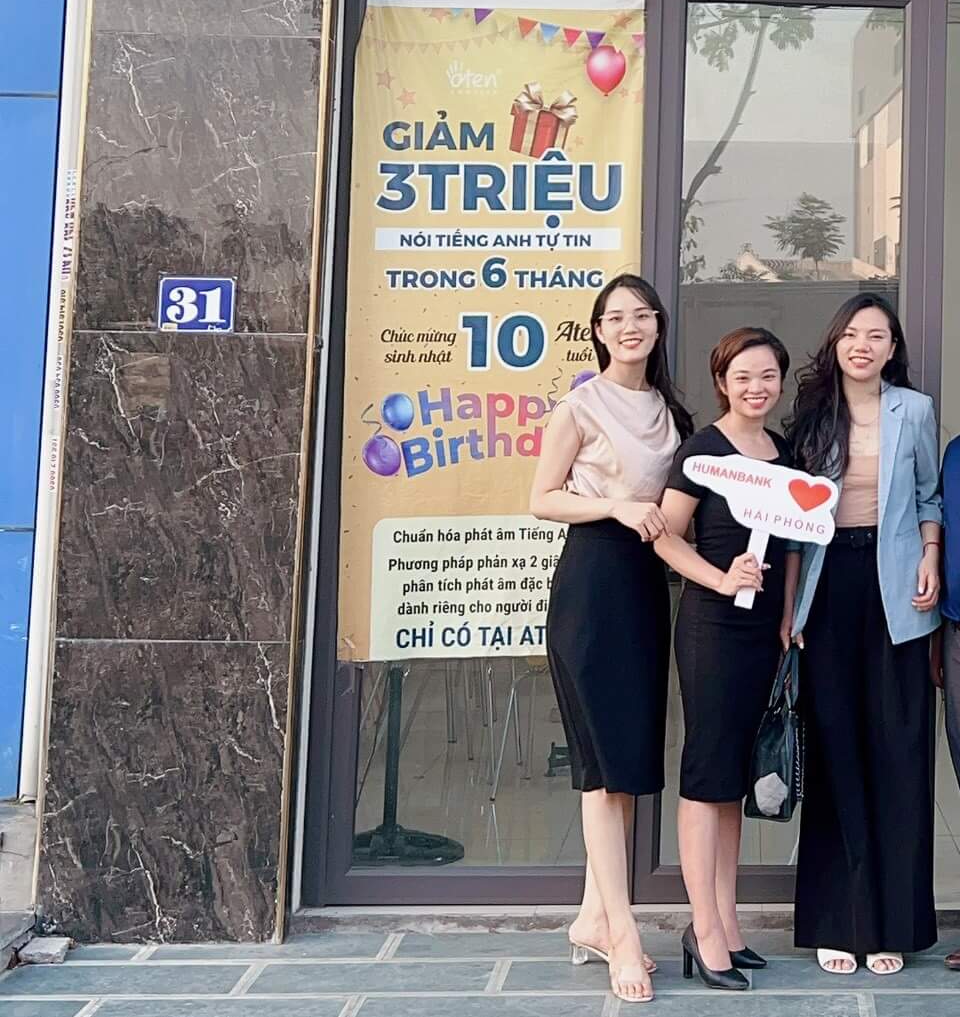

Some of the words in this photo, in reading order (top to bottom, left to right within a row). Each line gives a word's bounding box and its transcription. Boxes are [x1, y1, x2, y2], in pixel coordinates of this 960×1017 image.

[382, 110, 495, 151] GIẢM
[400, 231, 431, 247] NÓI
[436, 229, 488, 247] TIẾNG
[493, 234, 531, 247] ANH
[536, 233, 560, 251] TỰ
[563, 234, 591, 247] TIN
[386, 270, 476, 288] TRONG
[482, 256, 507, 288] 6
[514, 266, 603, 289] THÁNG
[166, 287, 226, 323] 31
[380, 328, 415, 343] Chúc
[462, 315, 545, 368] 10
[554, 320, 592, 342] Ate
[384, 350, 416, 363] sinh
[418, 350, 453, 365] nhật
[418, 387, 555, 428] Happ
[401, 426, 544, 478] Birthd
[692, 462, 773, 488] HUMANBANK
[393, 527, 433, 543] Chuẩn
[438, 528, 461, 542] hóa
[465, 527, 493, 544] phát
[497, 527, 515, 540] âm
[519, 525, 554, 544] Tiếng
[388, 558, 438, 572] Phương
[442, 556, 473, 571] pháp
[477, 554, 507, 570] phản
[512, 559, 526, 571] xạ
[530, 555, 538, 568] 2
[541, 555, 559, 570] giâ
[403, 579, 434, 595] phân
[438, 578, 462, 592] tích
[466, 578, 494, 593] phát
[498, 579, 516, 590] âm
[520, 577, 543, 592] đặc
[398, 600, 428, 615] dành
[433, 600, 465, 616] riêng
[469, 600, 492, 613] cho
[496, 600, 532, 616] người
[396, 620, 433, 648] CHỈ
[441, 621, 471, 647] CÓ
[478, 626, 512, 651] TẠI
[520, 625, 547, 645] AT
